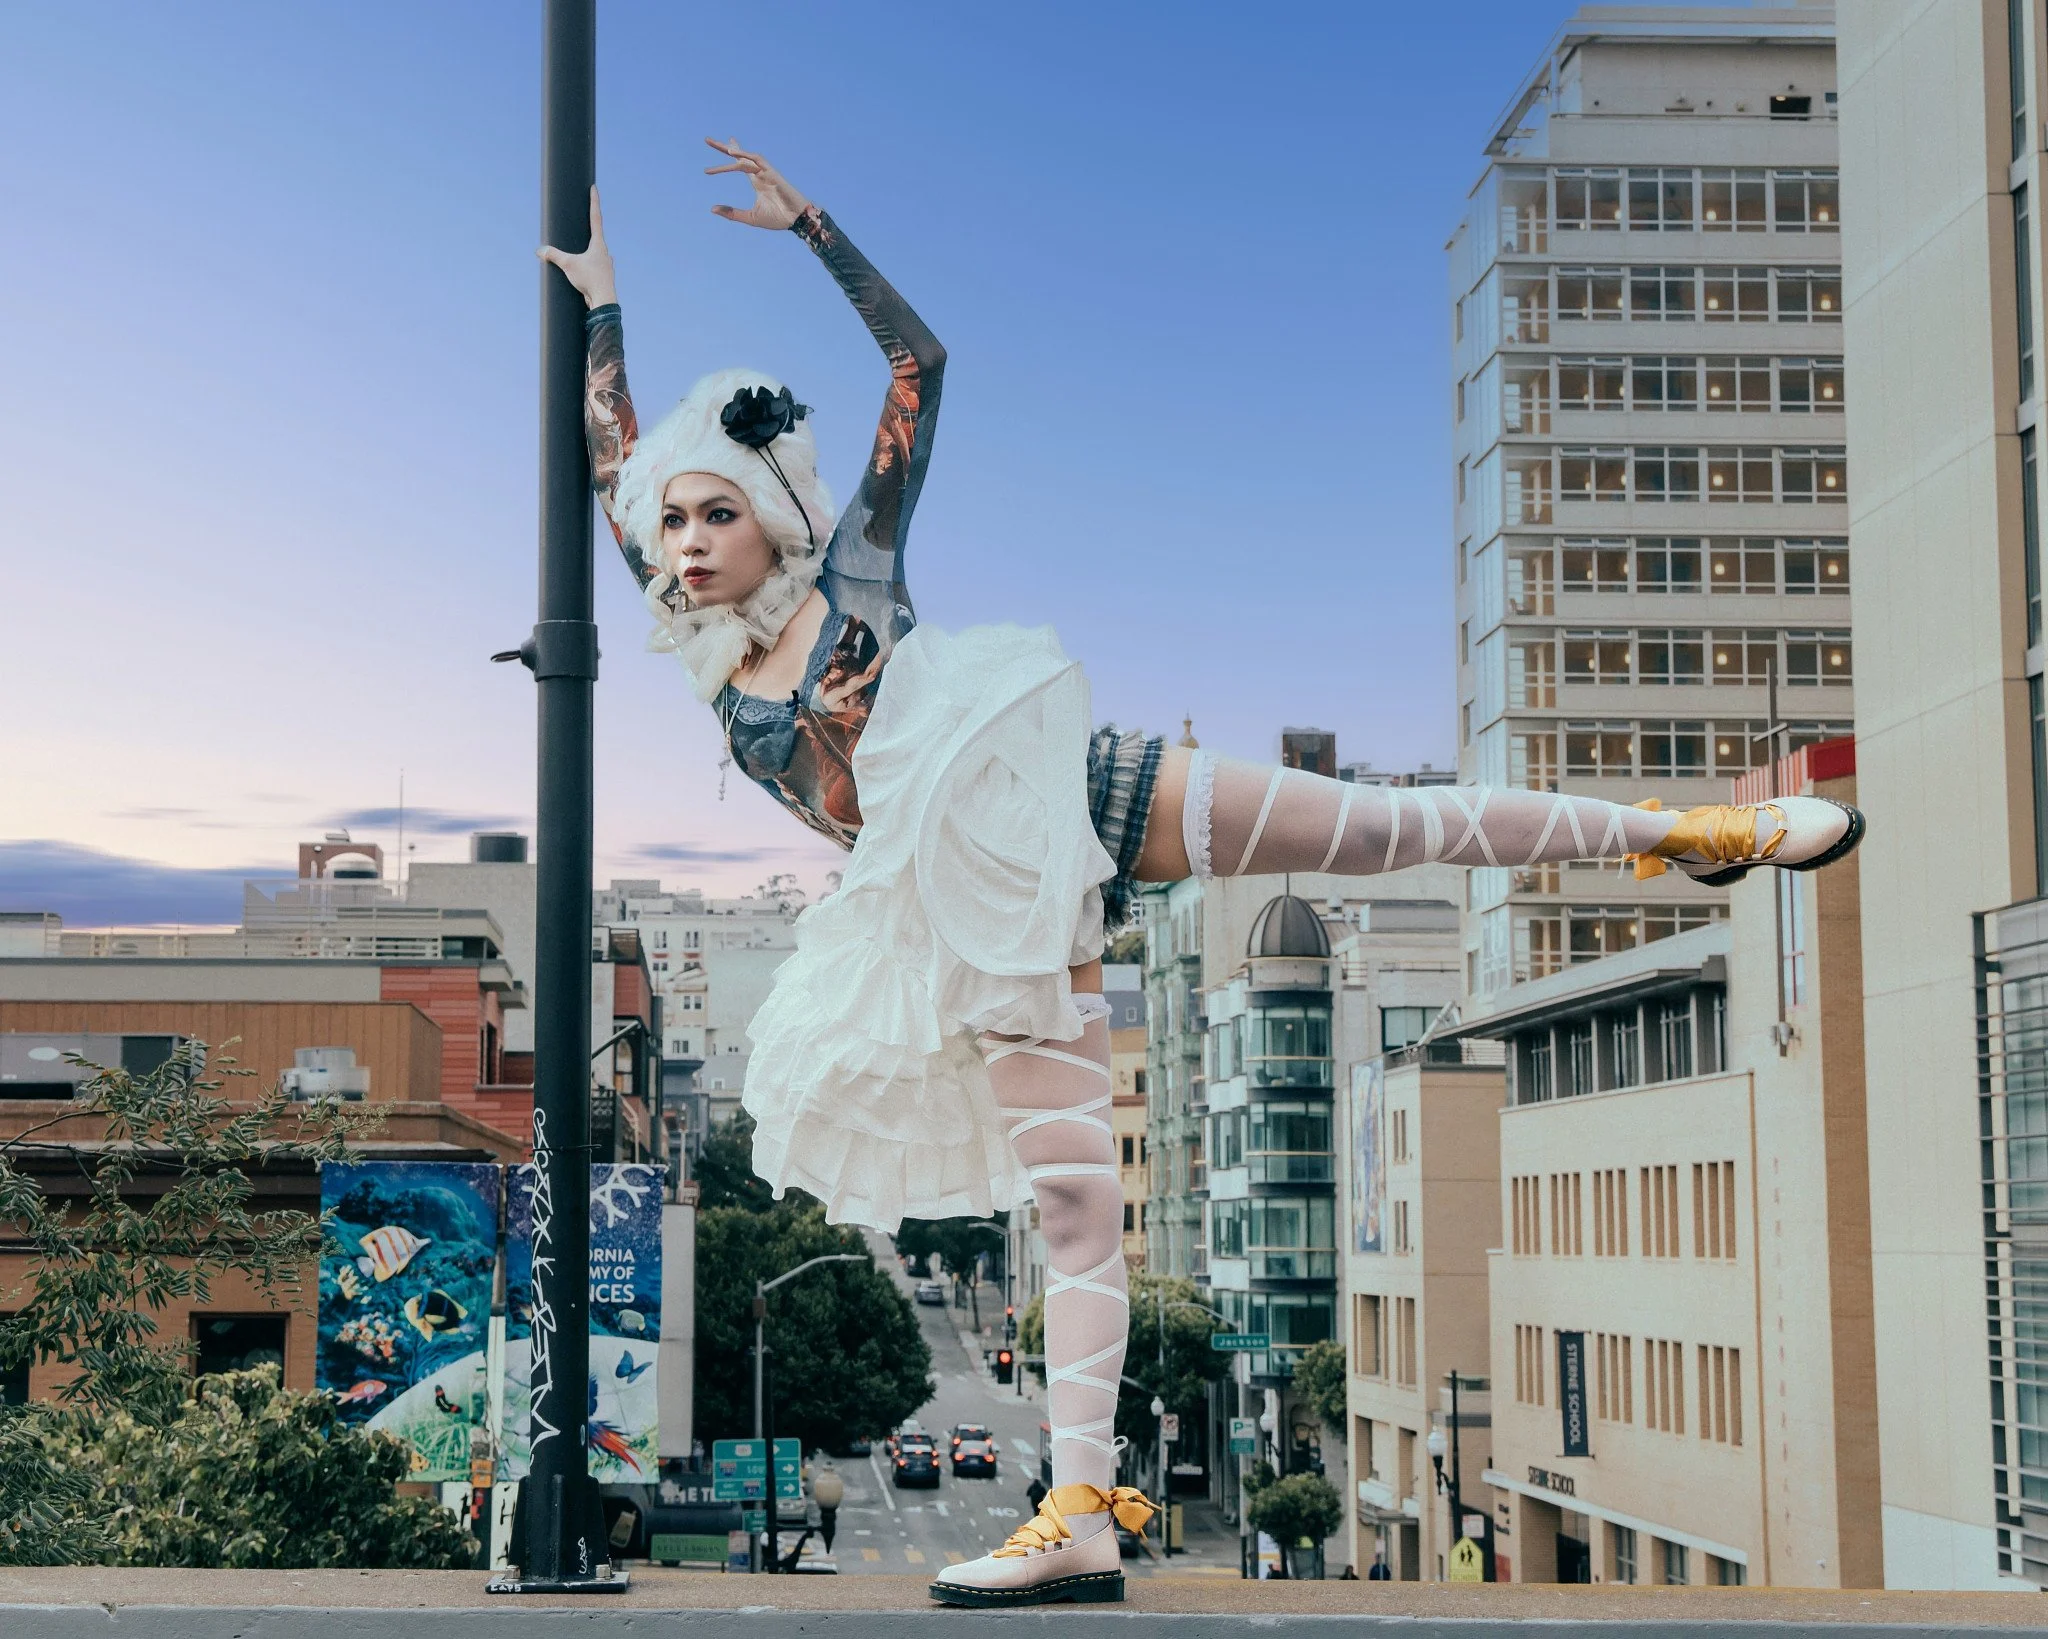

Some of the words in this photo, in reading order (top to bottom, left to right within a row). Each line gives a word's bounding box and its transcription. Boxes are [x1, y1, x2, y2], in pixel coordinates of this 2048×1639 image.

[613, 1265, 635, 1280] OF
[1219, 1337, 1266, 1347] Jackson
[1565, 1342, 1580, 1390] STERNE
[1233, 1421, 1244, 1435] P
[1568, 1392, 1581, 1447] SCHOOL
[1551, 1472, 1576, 1497] SCHOOL
